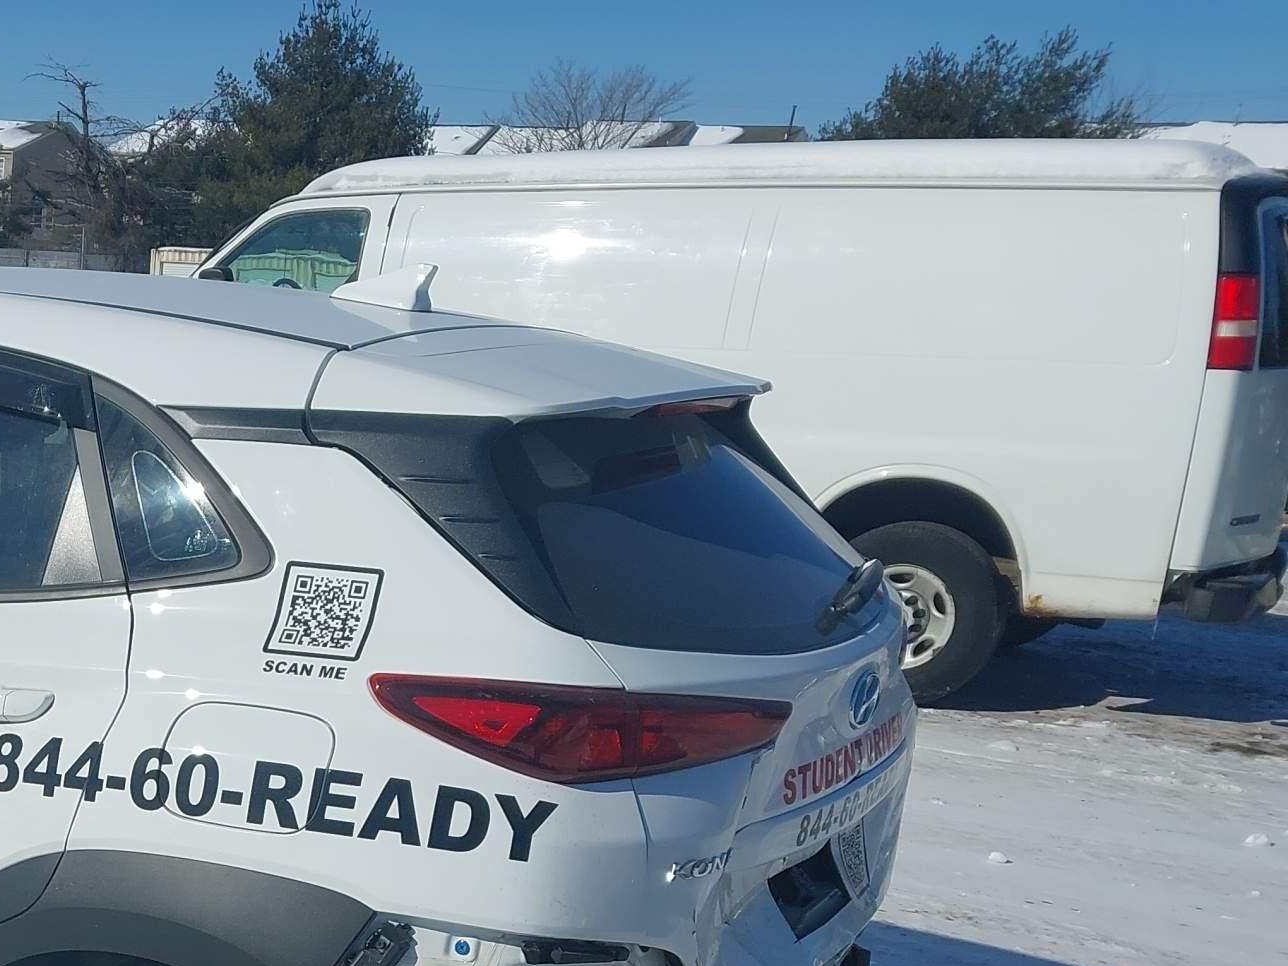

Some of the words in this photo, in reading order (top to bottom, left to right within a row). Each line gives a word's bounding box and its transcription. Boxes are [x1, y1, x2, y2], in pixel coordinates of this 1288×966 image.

[262, 659, 314, 676] SCAN
[318, 665, 348, 680] ME
[783, 738, 863, 805] STUDENT
